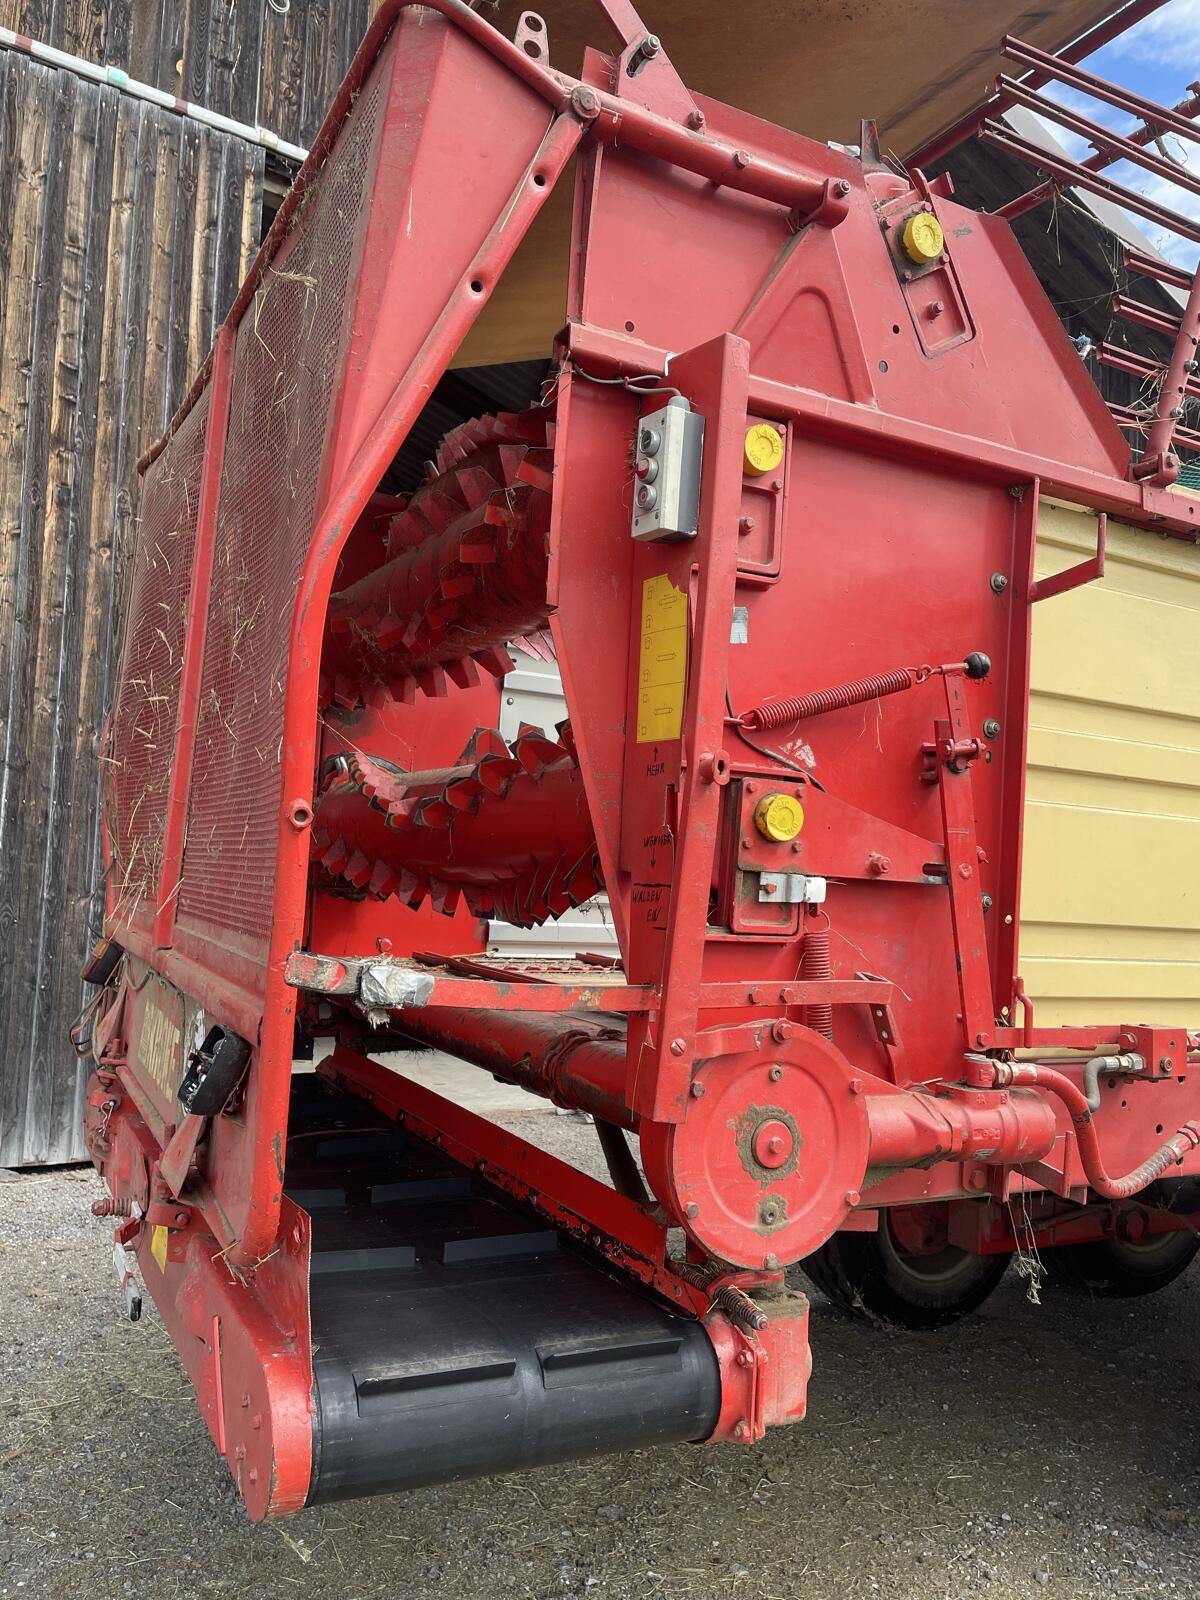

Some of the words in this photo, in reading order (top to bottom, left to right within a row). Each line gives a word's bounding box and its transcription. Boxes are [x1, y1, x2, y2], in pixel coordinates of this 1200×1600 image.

[646, 763, 665, 776] MEHR
[631, 889, 662, 904] WALZEN
[647, 906, 662, 922] EIN
